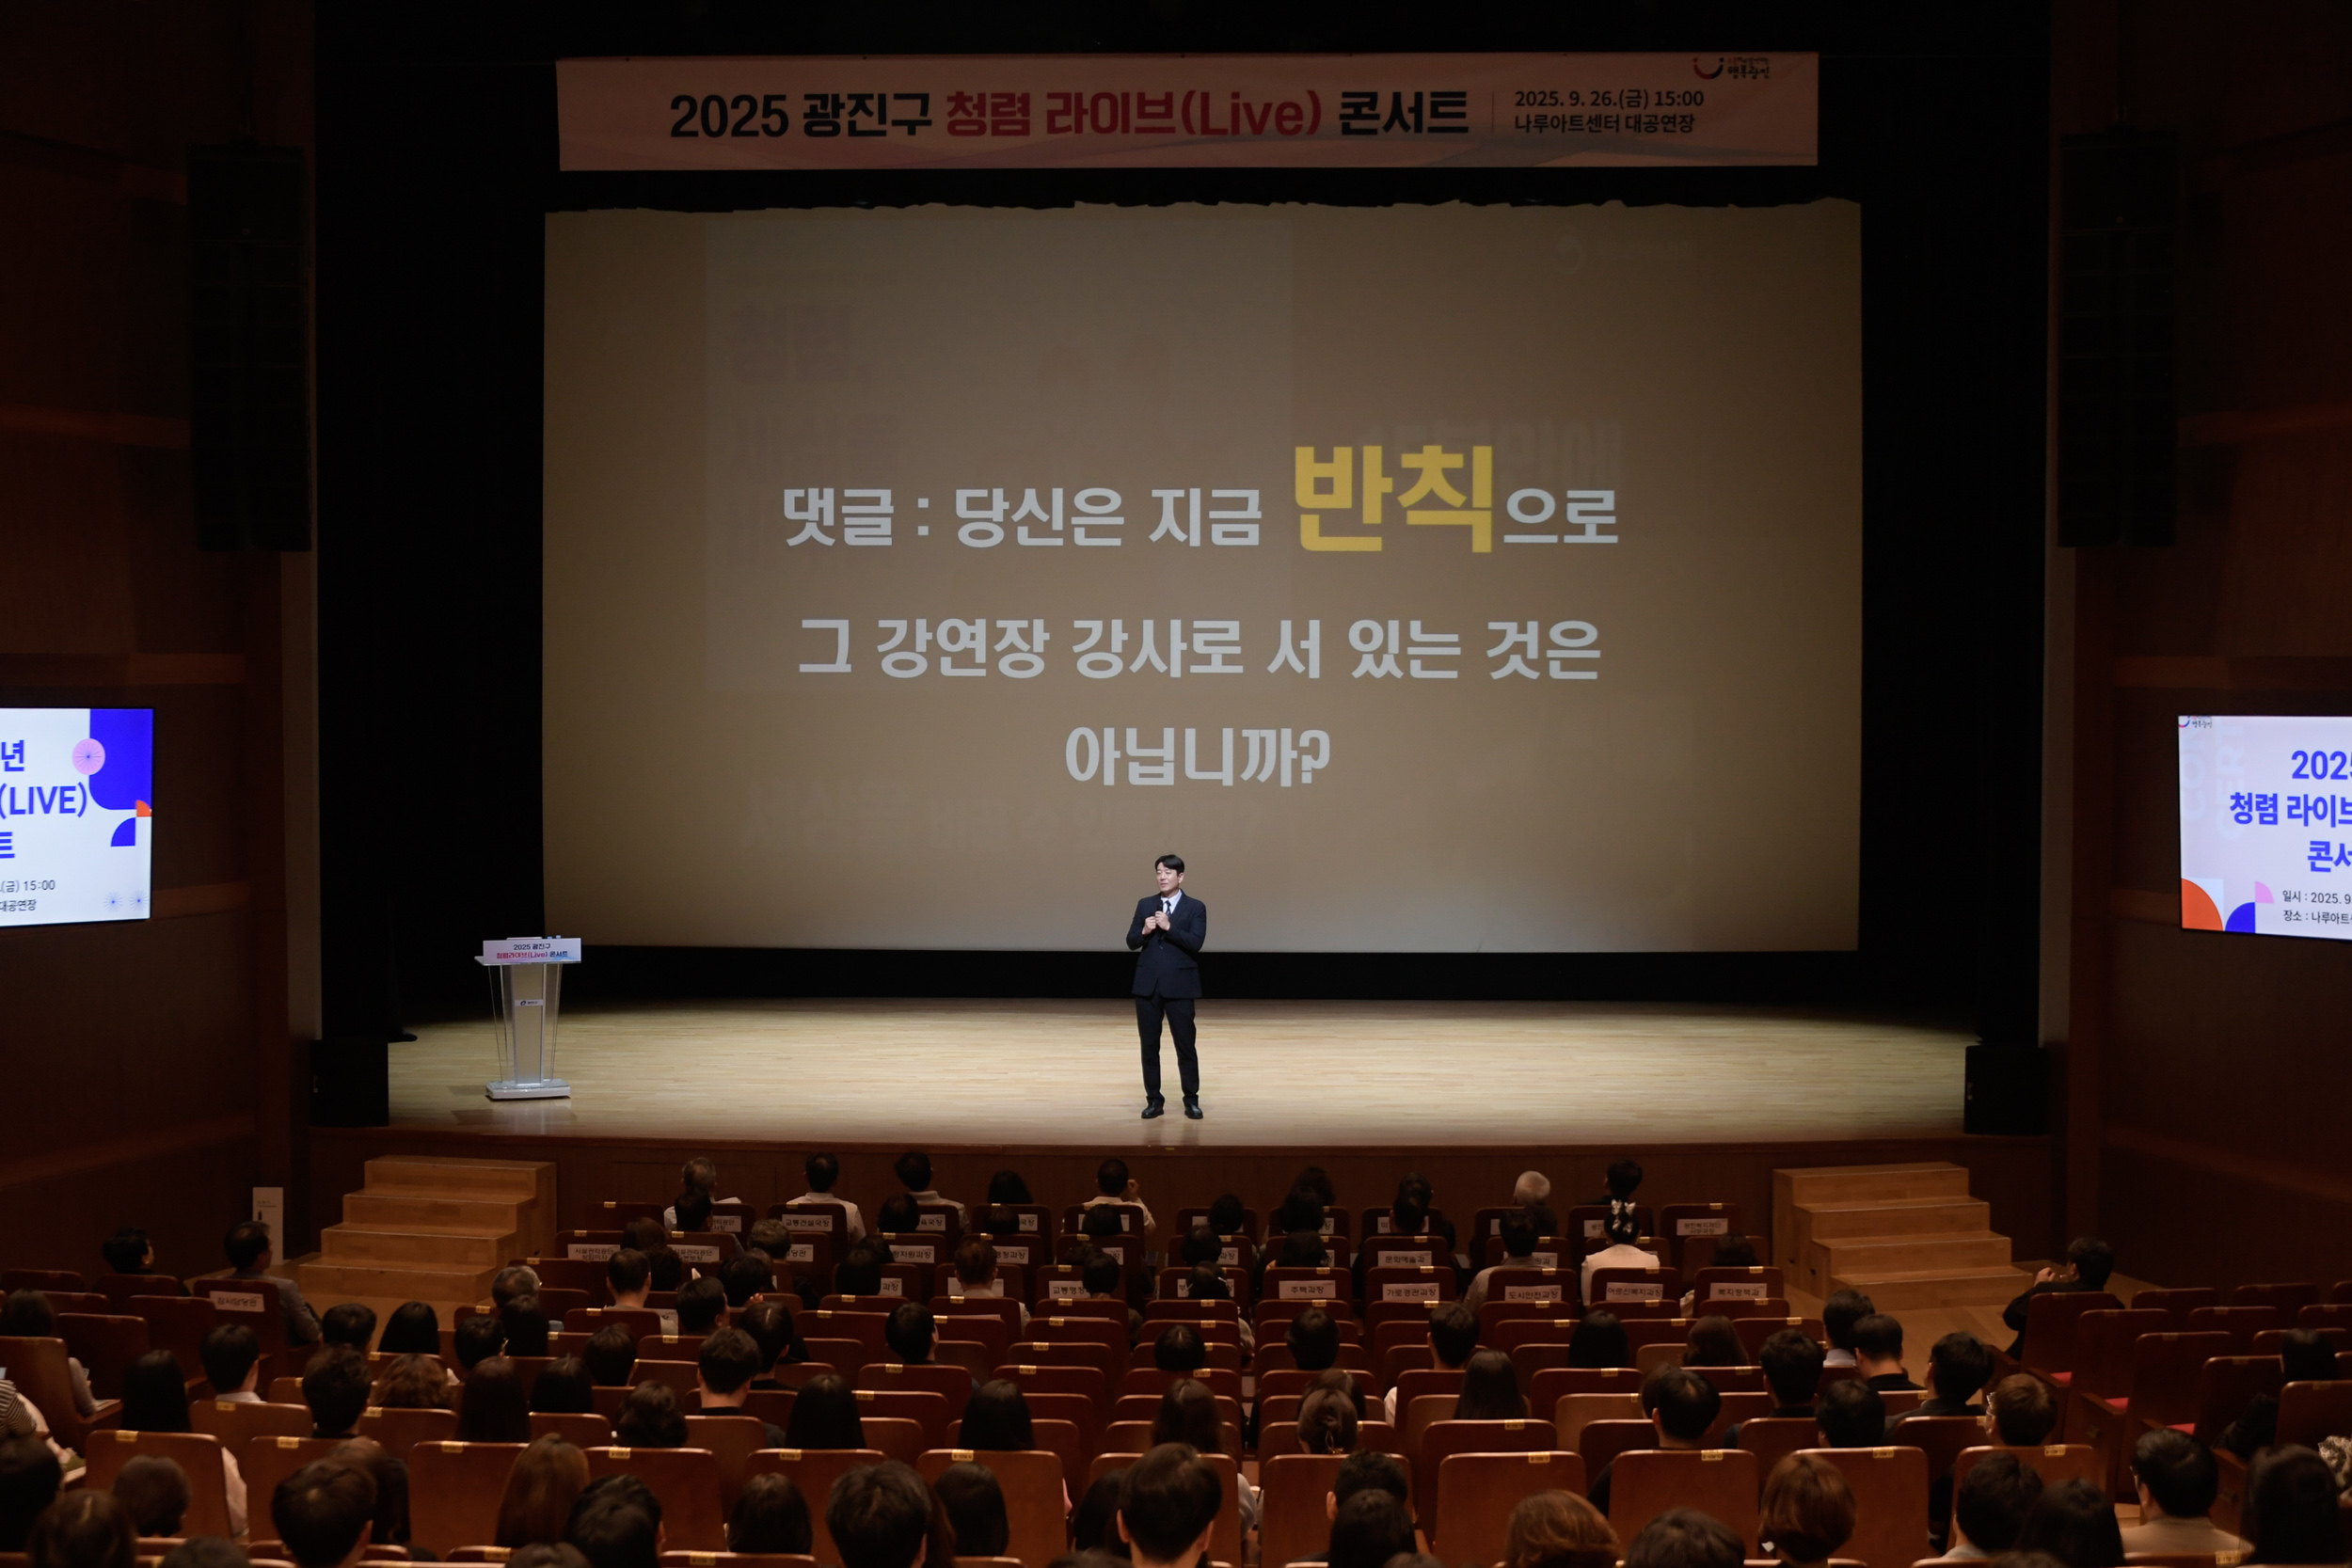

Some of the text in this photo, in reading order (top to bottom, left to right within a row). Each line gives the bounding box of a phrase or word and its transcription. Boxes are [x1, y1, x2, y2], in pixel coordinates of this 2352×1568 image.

[1515, 89, 1705, 109] 2025. 9. 26.(금) 15:00
[671, 88, 1470, 139] 2025 광진구 청렴 라이브(Live) 콘서트
[1514, 112, 1697, 135] 나루아트센터 대공연장
[783, 487, 894, 547] 댓글
[955, 487, 1125, 548] 당신은
[1149, 487, 1263, 547] 지금
[799, 618, 1600, 680] 그 강연장 강사로 서 있는 것은
[1065, 726, 1331, 788] 아닙니까?
[2291, 750, 2352, 780] 202
[2230, 792, 2279, 825] 청렴
[24, 879, 56, 892] 15:00
[2282, 890, 2301, 903] 일시
[2283, 910, 2302, 922] 장소
[1053, 1286, 1089, 1294] 교통행정
